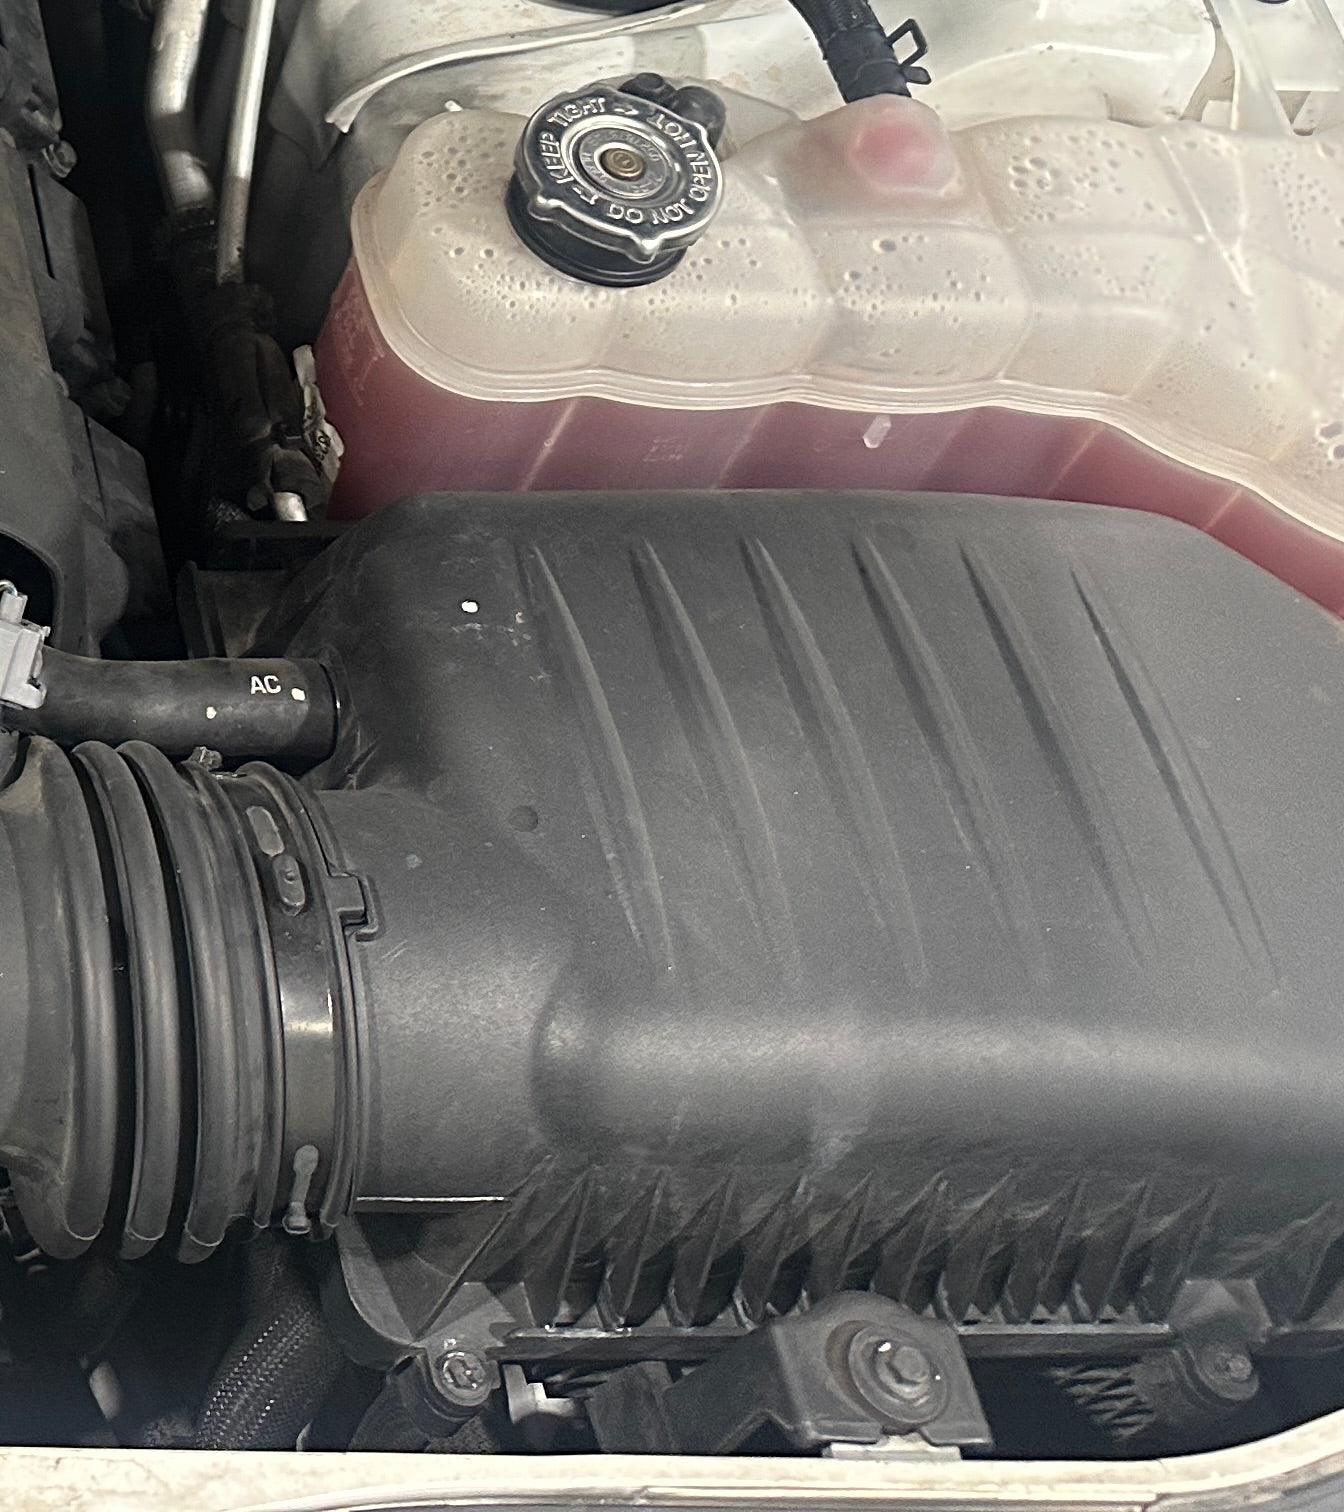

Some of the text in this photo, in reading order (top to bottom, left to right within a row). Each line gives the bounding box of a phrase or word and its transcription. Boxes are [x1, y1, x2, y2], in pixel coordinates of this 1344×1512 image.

[539, 97, 606, 185] KEEP TIGHT
[645, 112, 699, 149] HOT
[686, 150, 713, 203] OPEN
[606, 202, 644, 224] DO
[649, 197, 695, 226] NOT
[250, 675, 282, 694] AC
